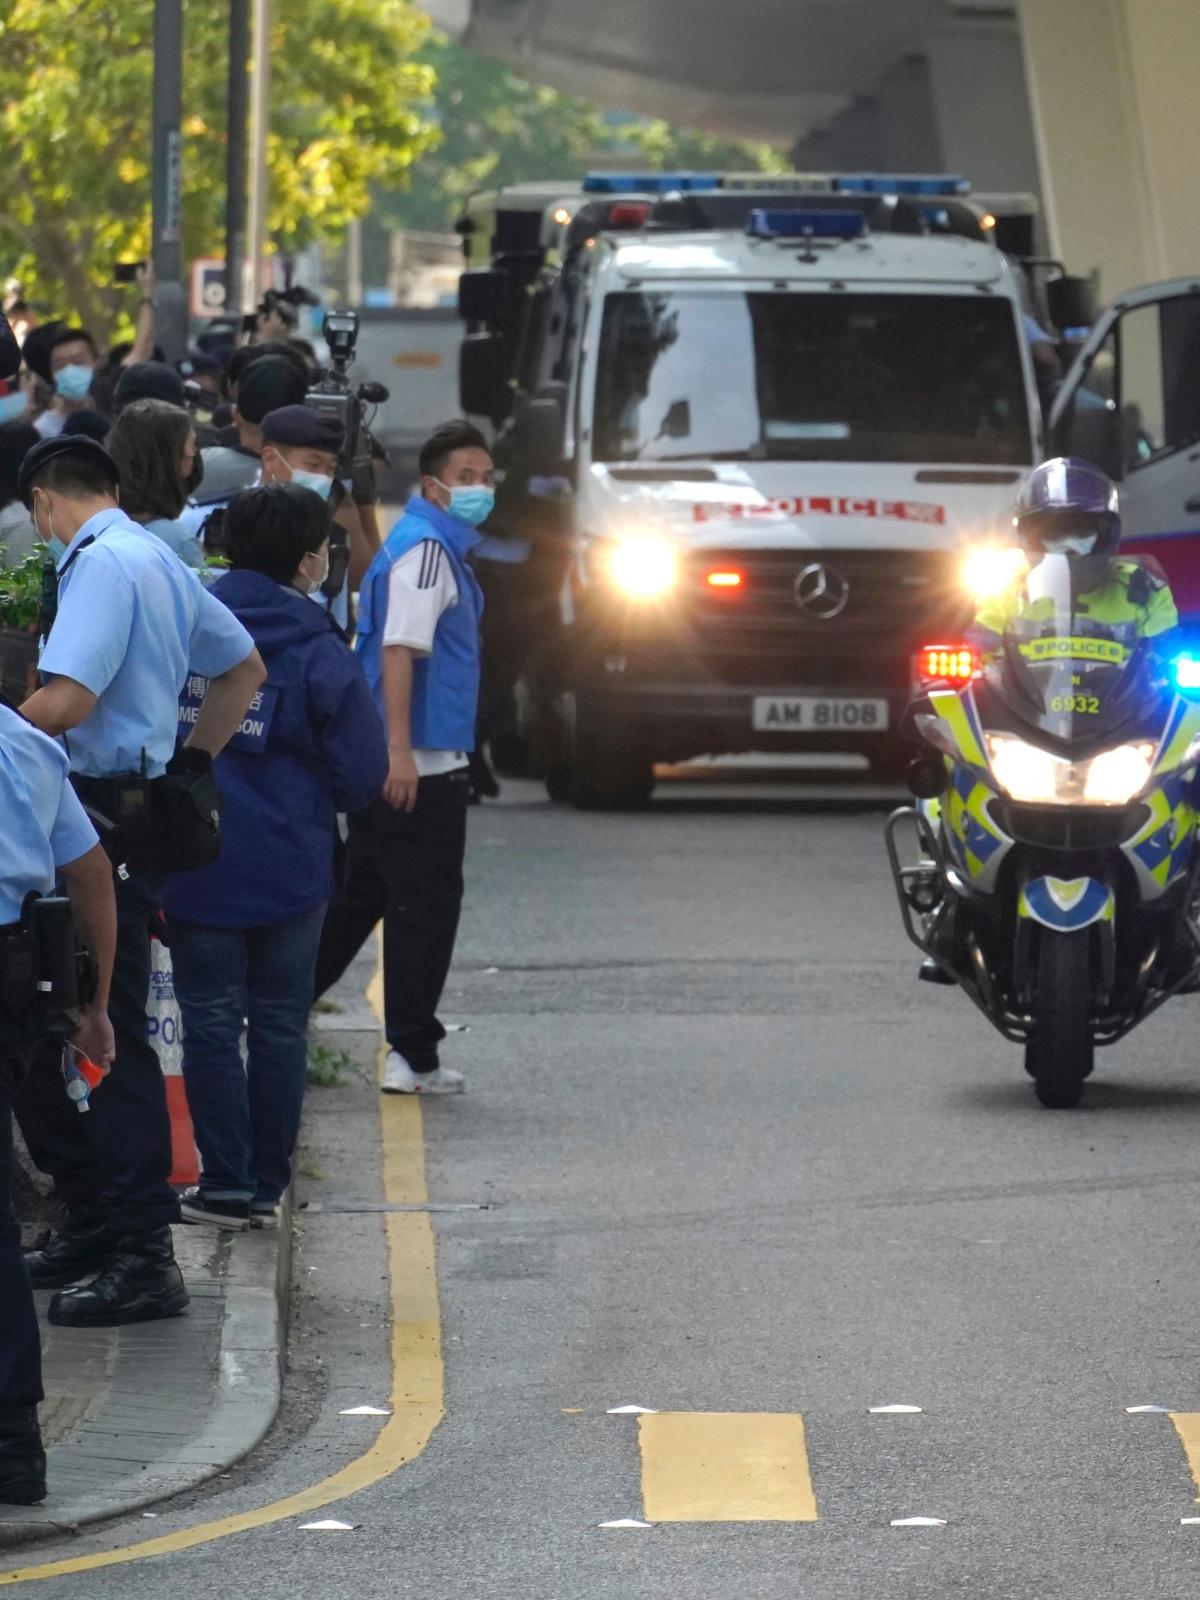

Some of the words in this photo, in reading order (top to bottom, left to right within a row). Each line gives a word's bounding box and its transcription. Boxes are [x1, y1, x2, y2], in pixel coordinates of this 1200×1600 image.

[1047, 641, 1106, 656] POLICE
[1051, 695, 1100, 713] 6932
[766, 702, 802, 725] AM
[813, 702, 877, 725] 8108
